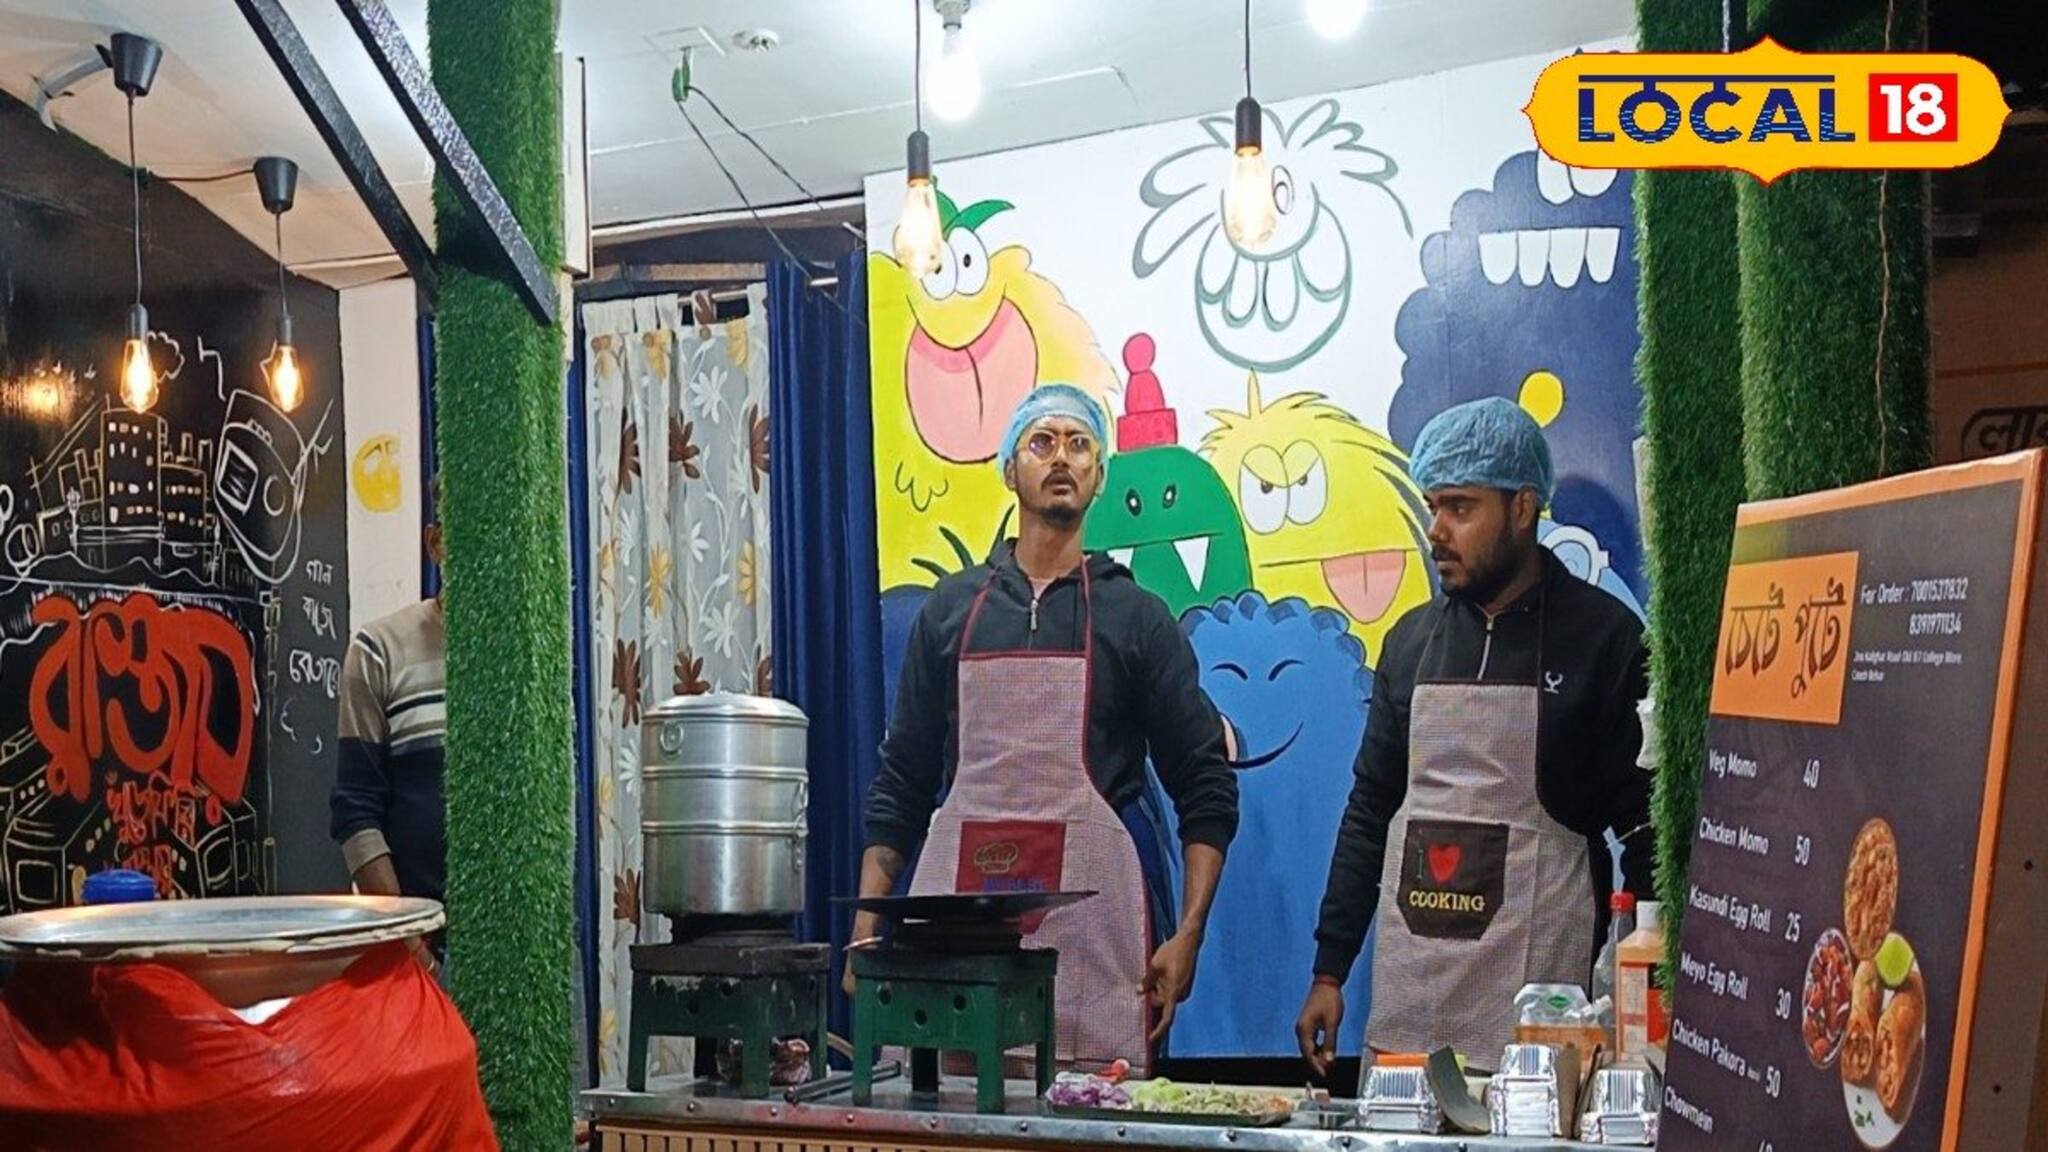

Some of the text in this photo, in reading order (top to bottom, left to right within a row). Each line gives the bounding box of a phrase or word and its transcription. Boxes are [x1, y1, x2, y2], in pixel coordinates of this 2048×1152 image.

[1861, 584, 1876, 605] For
[1878, 582, 1904, 604] Order
[1709, 748, 1821, 789] Veg Momo 40
[1699, 816, 1811, 866] Chicken Momo 50
[1409, 890, 1486, 913] COOKING
[1689, 883, 1802, 943] Kasundi Egg Roll 25
[1680, 951, 1792, 1020] Meyo Egg Roll 30
[1672, 1018, 1710, 1058] Chicken
[1711, 1038, 1747, 1077] Pakora
[1765, 1065, 1782, 1099] 50
[1664, 1085, 1714, 1134] Chowmein
